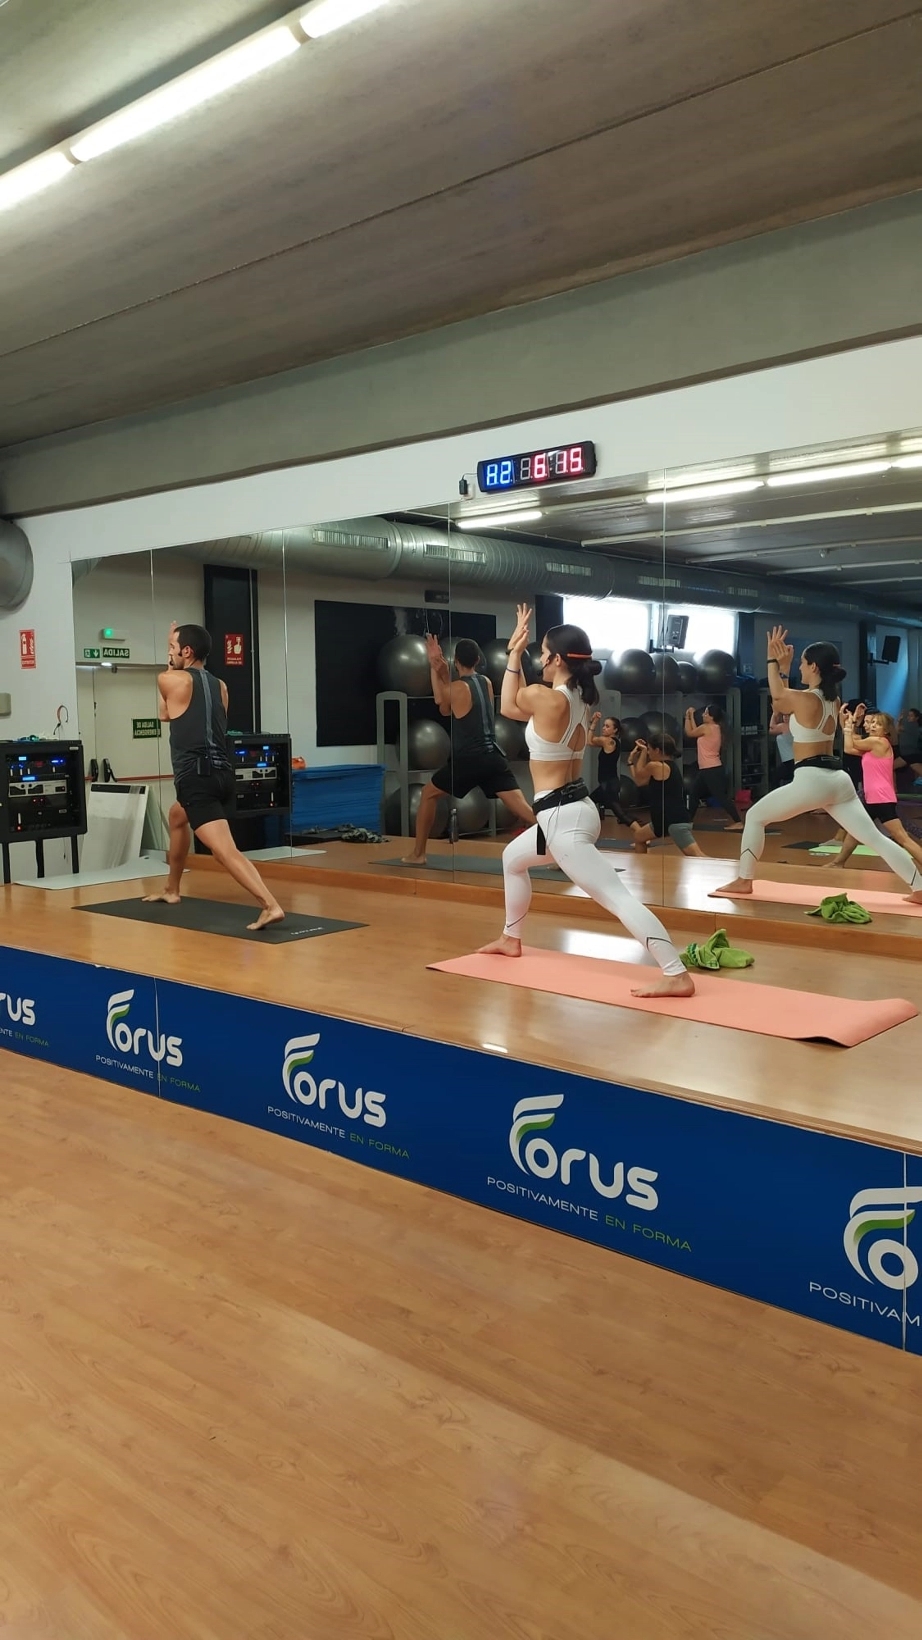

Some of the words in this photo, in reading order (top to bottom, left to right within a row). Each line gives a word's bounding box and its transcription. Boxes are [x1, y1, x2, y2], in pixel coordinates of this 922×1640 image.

[26, 1034, 49, 1047] FORMA
[95, 1054, 154, 1079] POSITIVAMENTE
[157, 1072, 168, 1083] EN
[170, 1077, 201, 1093] FORMA
[282, 1033, 387, 1128] Forus
[267, 1105, 346, 1139] POSITIVAMENTE
[350, 1132, 364, 1145] EN
[368, 1138, 410, 1159] FORMA
[509, 1094, 659, 1211] Forus
[487, 1176, 599, 1221] POSITIVAMENTE
[605, 1214, 626, 1231] EN
[633, 1223, 692, 1252] FORMA
